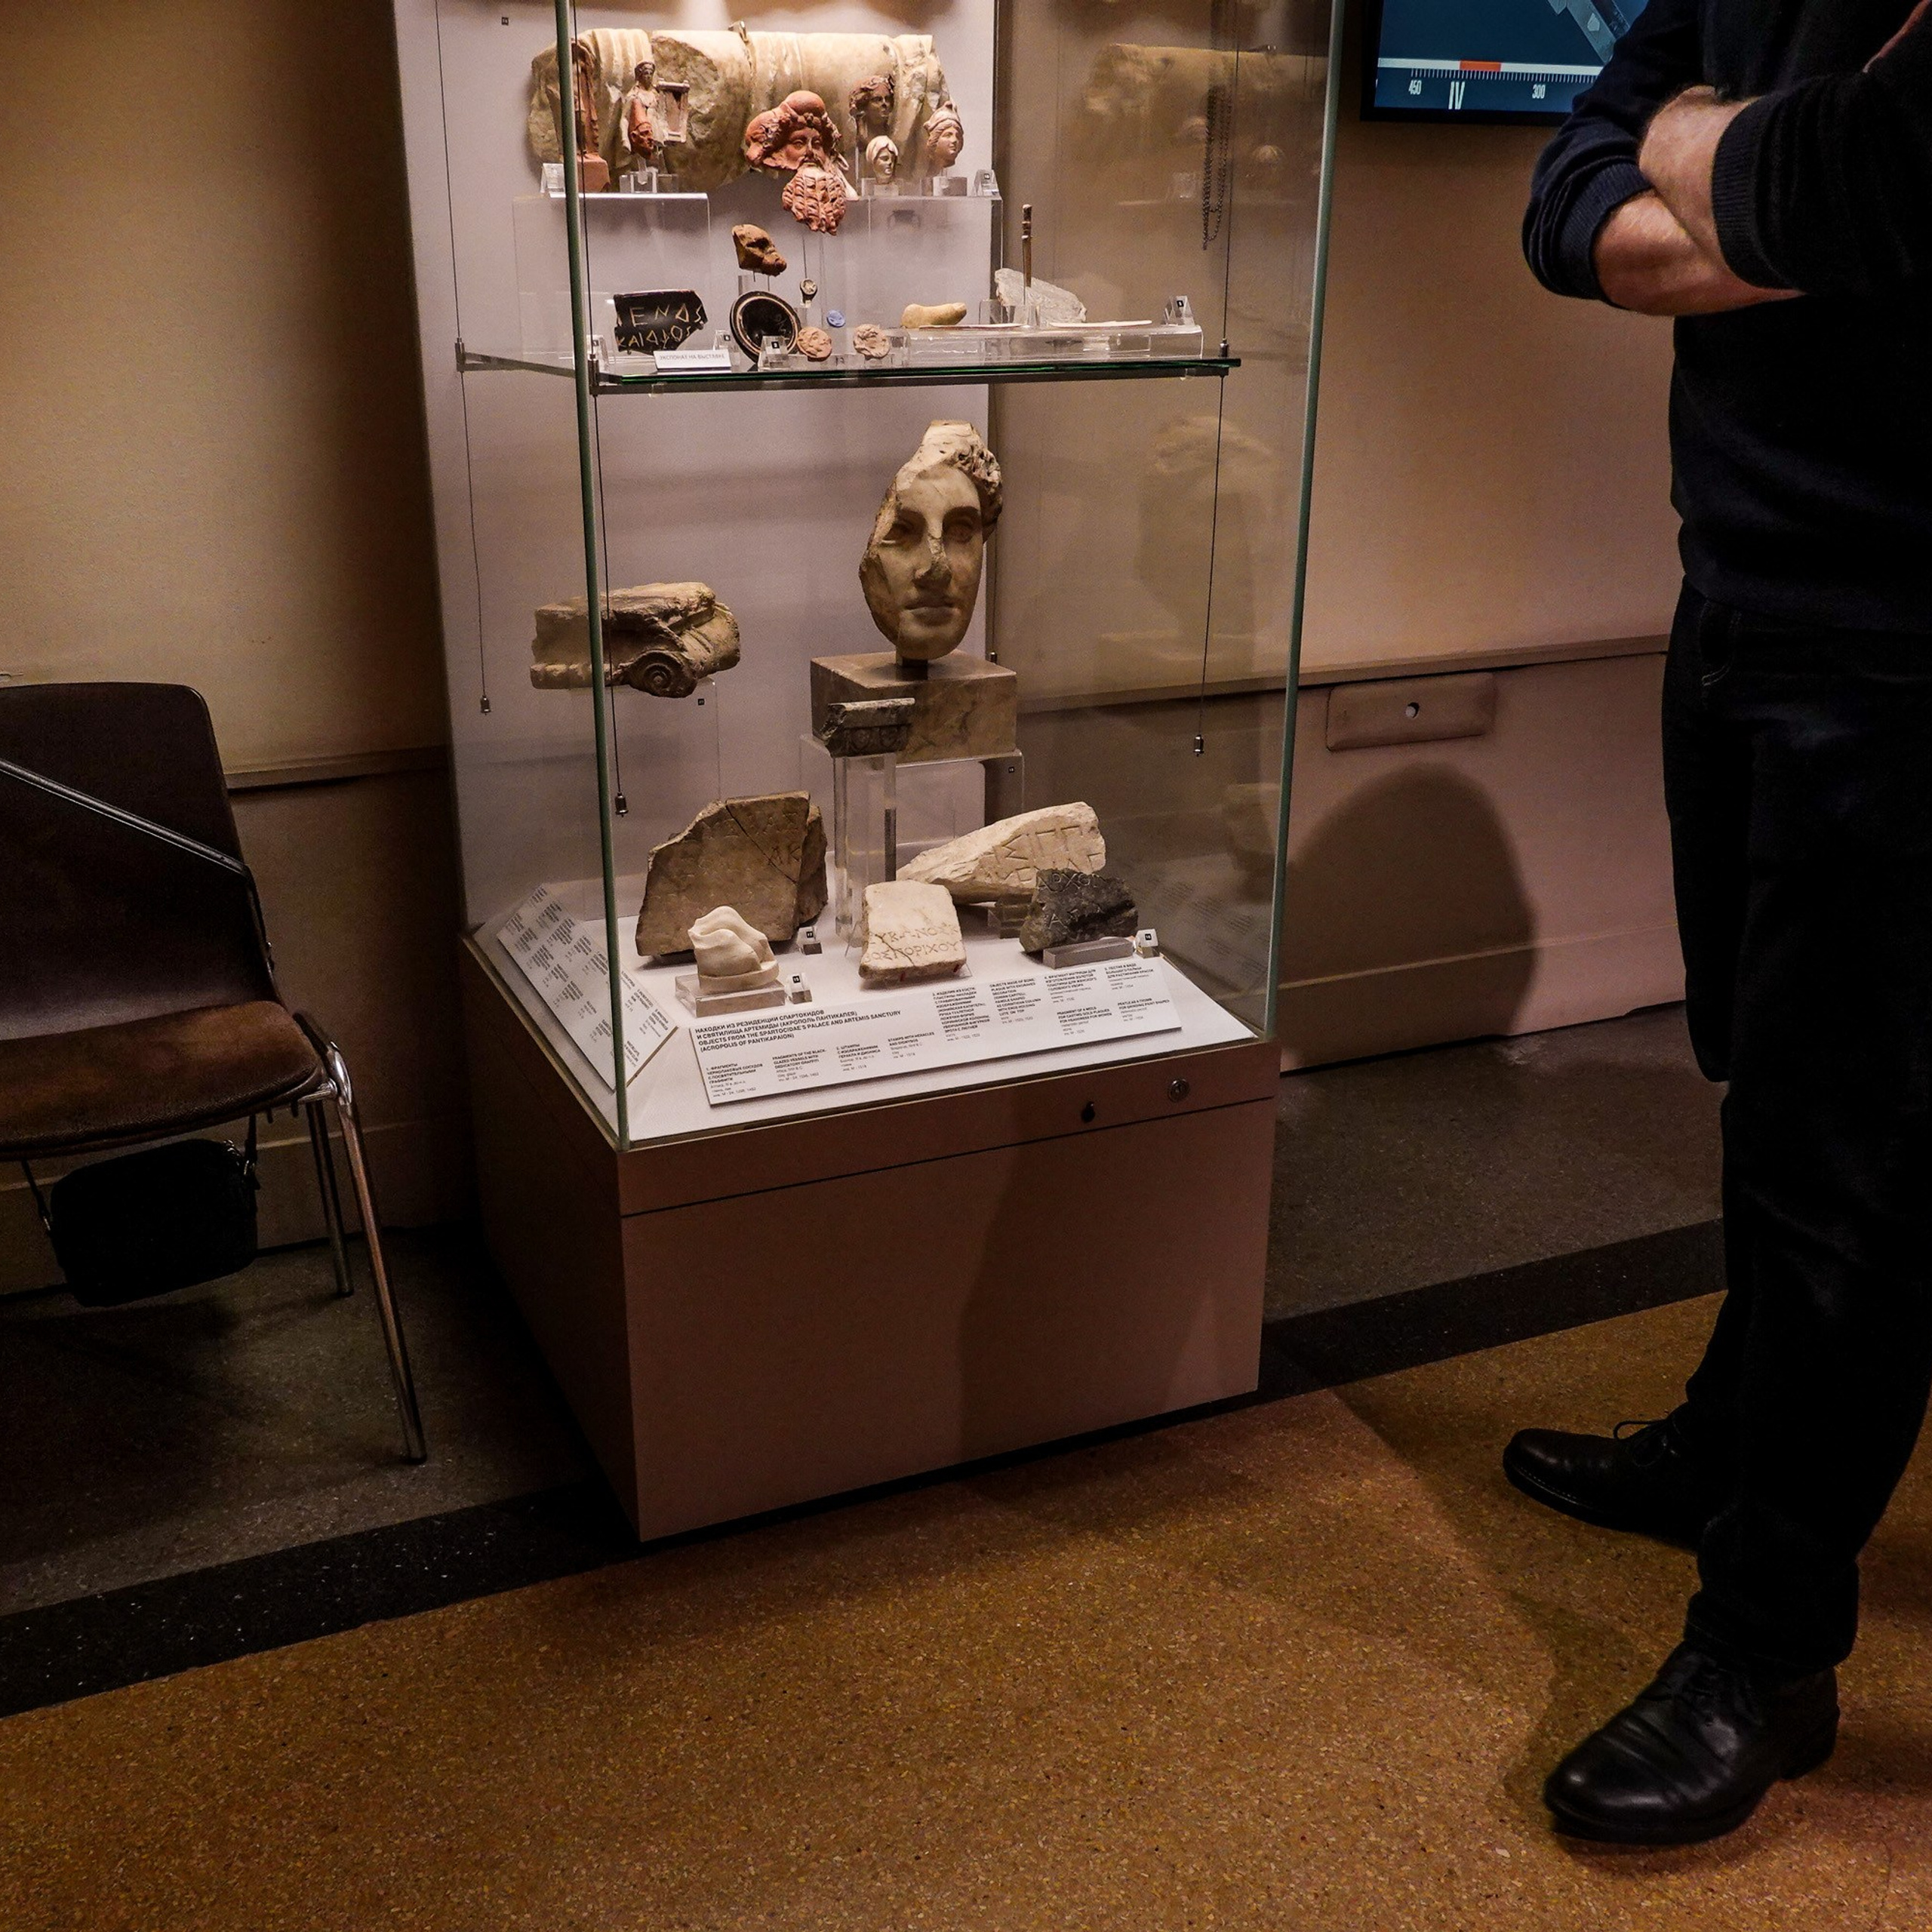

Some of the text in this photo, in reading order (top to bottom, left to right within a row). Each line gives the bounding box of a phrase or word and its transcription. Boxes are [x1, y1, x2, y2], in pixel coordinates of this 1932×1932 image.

[1408, 79, 1546, 109] 450 IV 300
[694, 1024, 724, 1033] НАХОДКИ
[736, 1016, 778, 1026] РЕЗИДЕНЦИИ
[779, 1009, 824, 1020] СПАРТОКИДОВ
[702, 1028, 743, 1038] СВЯТИЛИЩА
[743, 1023, 779, 1032] АРТЕМИДЫ
[698, 1036, 727, 1045] OBJECTS
